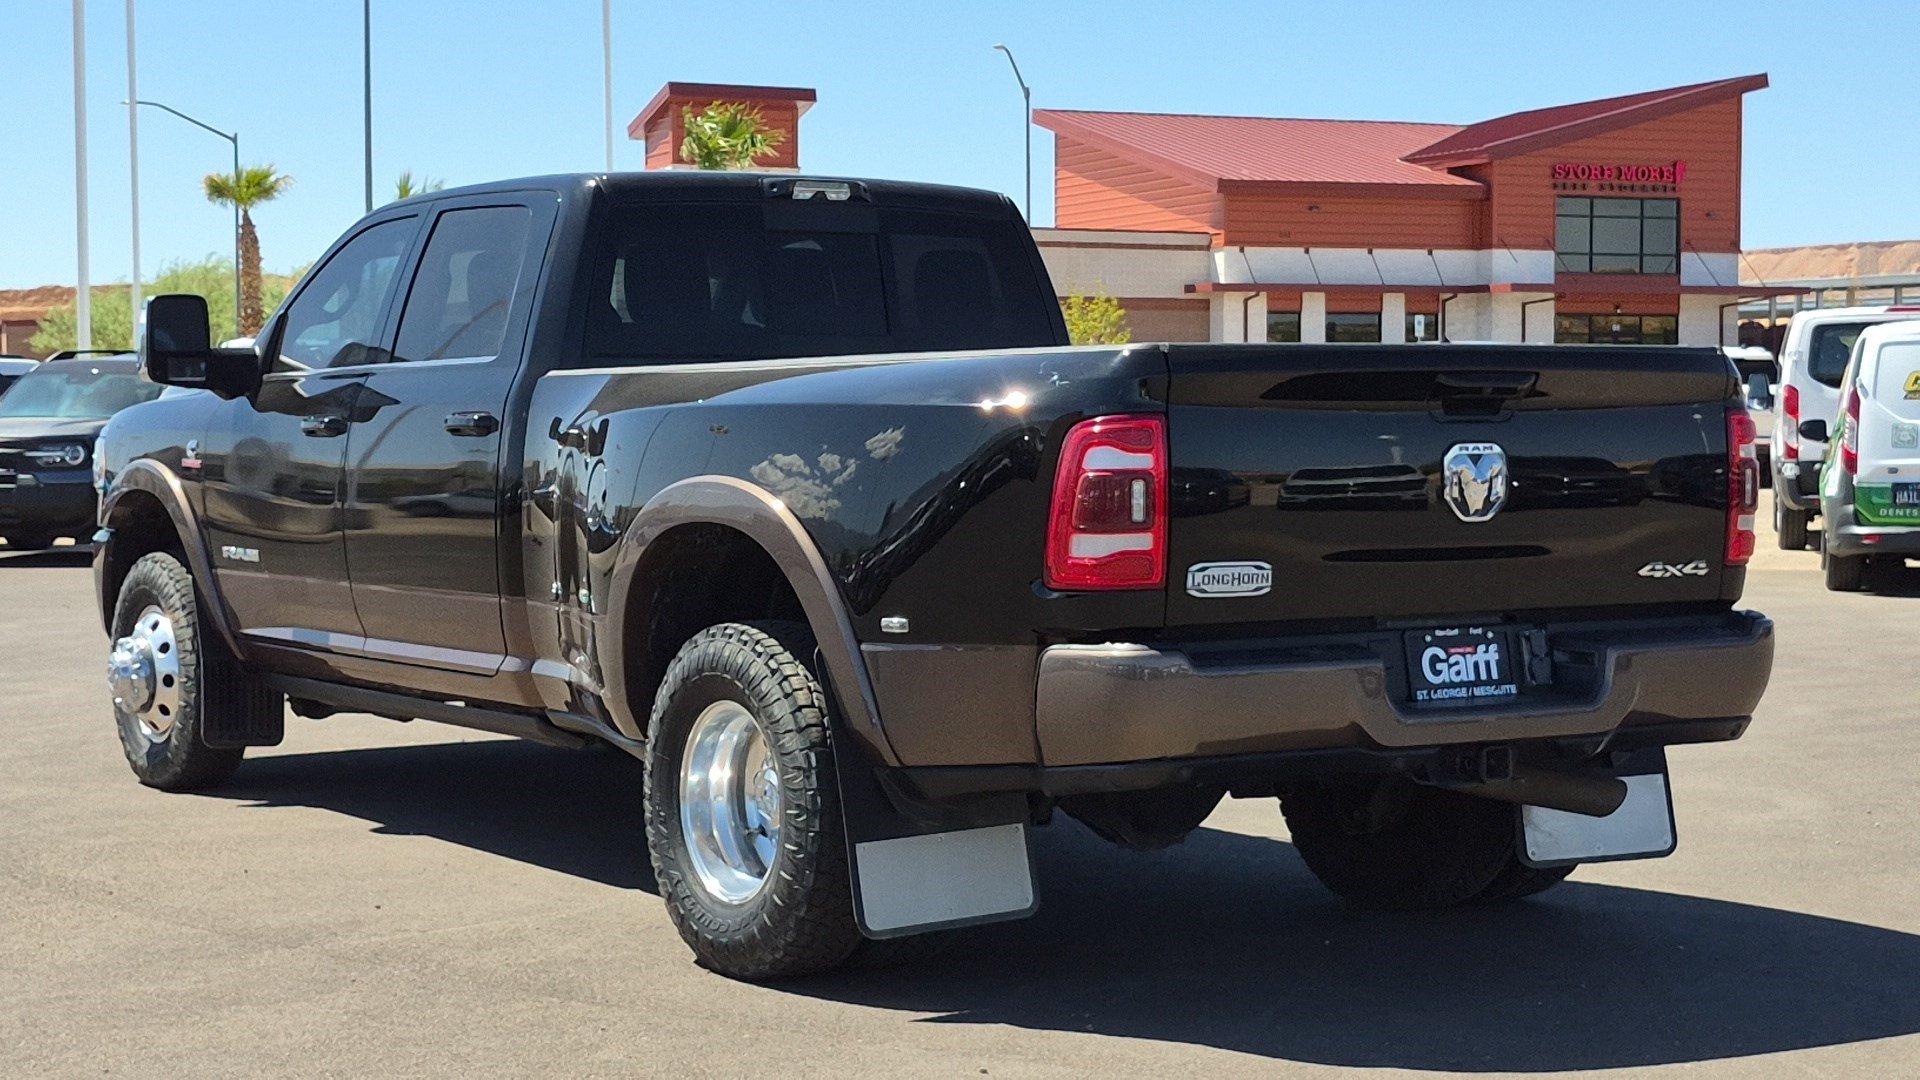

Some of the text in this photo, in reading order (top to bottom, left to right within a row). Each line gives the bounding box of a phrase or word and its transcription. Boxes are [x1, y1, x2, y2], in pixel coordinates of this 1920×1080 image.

[1553, 163, 1614, 181] STORE
[1421, 644, 1500, 685] Garff
[1416, 689, 1430, 701] ST.
[1431, 686, 1468, 700] GEORGE
